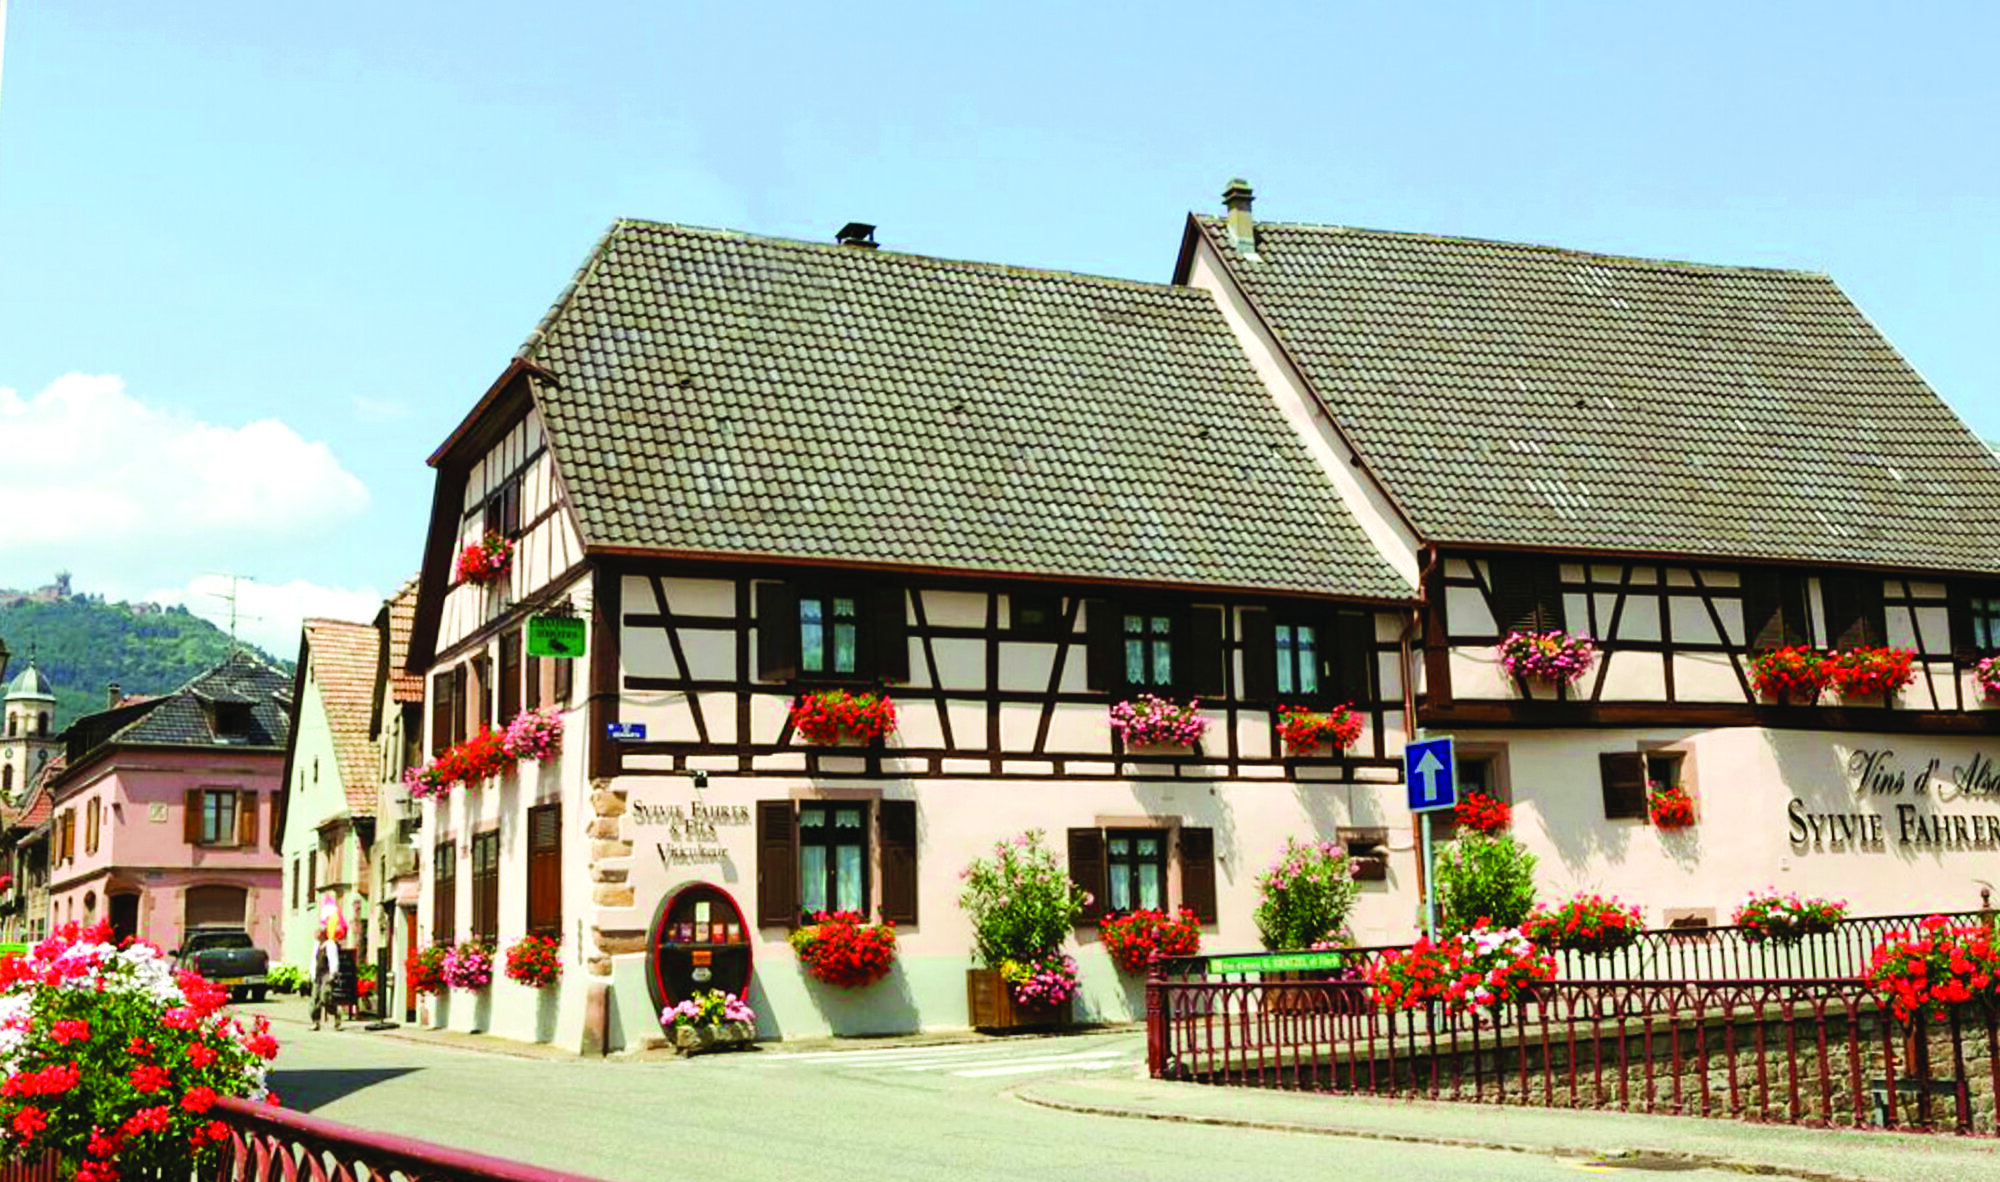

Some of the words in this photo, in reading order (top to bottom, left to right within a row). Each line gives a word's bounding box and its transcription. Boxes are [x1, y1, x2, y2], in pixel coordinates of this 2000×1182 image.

[1850, 749, 1905, 797] Vins
[691, 801, 749, 818] FAHRER
[1788, 798, 1882, 843] SYLVIE
[1897, 803, 2000, 842] FAHRER
